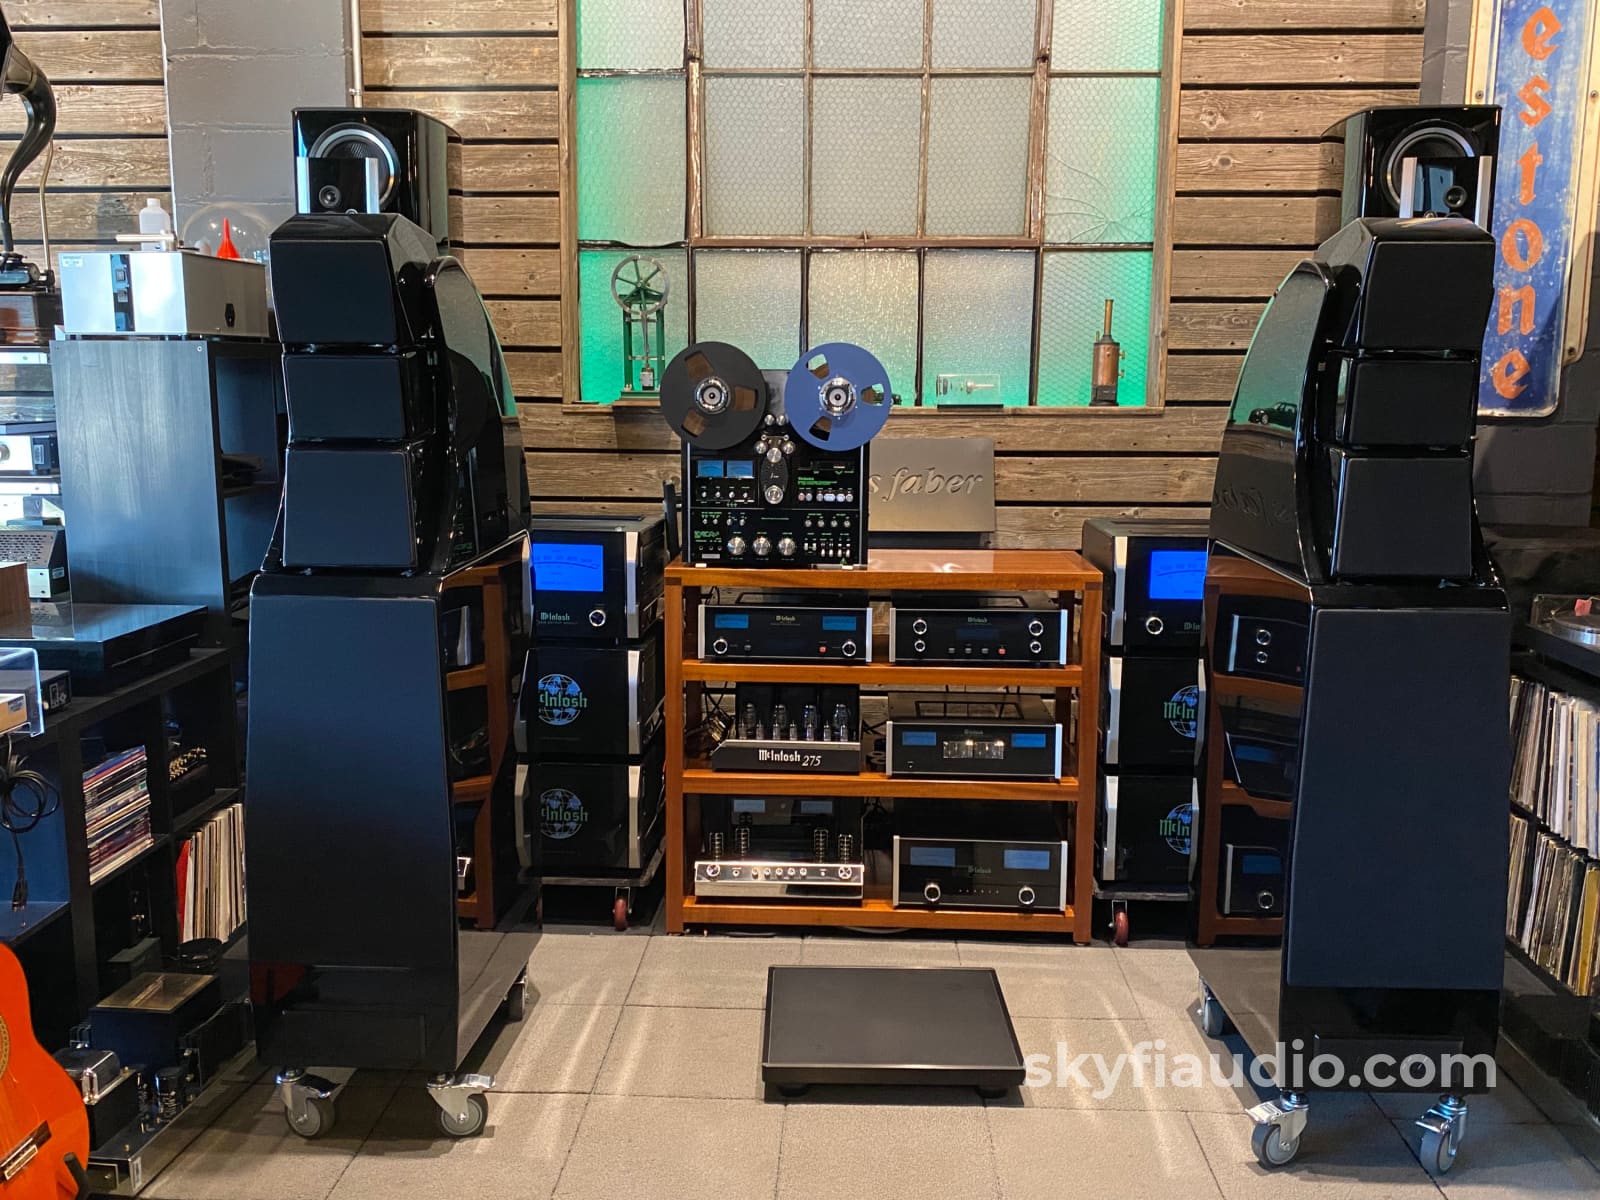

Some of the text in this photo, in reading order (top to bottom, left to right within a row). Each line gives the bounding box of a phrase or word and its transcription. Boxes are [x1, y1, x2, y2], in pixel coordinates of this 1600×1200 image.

[881, 466, 983, 502] faber
[539, 690, 588, 708] cIntosh
[1163, 701, 1195, 719] McIn
[758, 749, 822, 767] McIntosh 275
[541, 804, 589, 822] cIntosh
[1159, 819, 1190, 836] McIn
